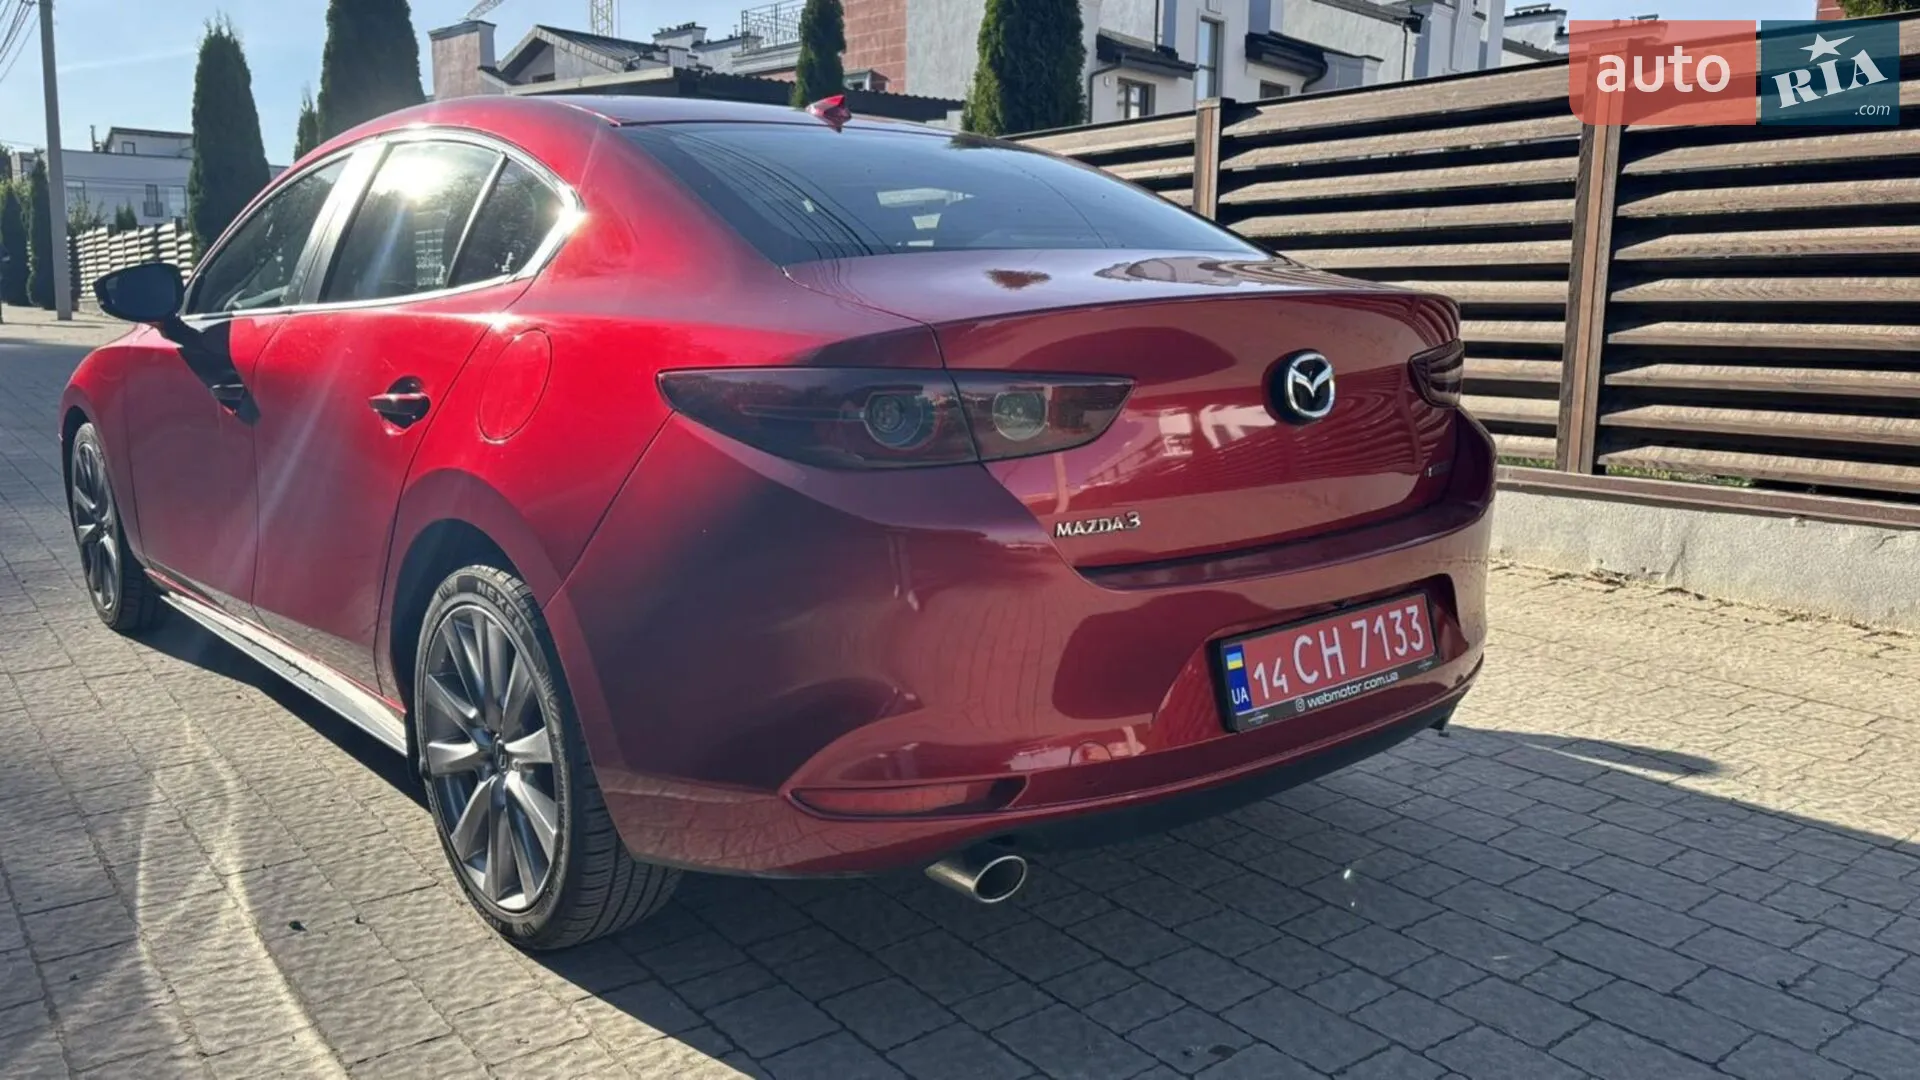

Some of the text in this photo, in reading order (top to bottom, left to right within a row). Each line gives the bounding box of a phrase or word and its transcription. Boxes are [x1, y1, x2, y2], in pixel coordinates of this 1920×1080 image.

[476, 580, 526, 637] NEXEN
[1253, 604, 1425, 699] 14 CH 7133
[1230, 686, 1250, 705] UA
